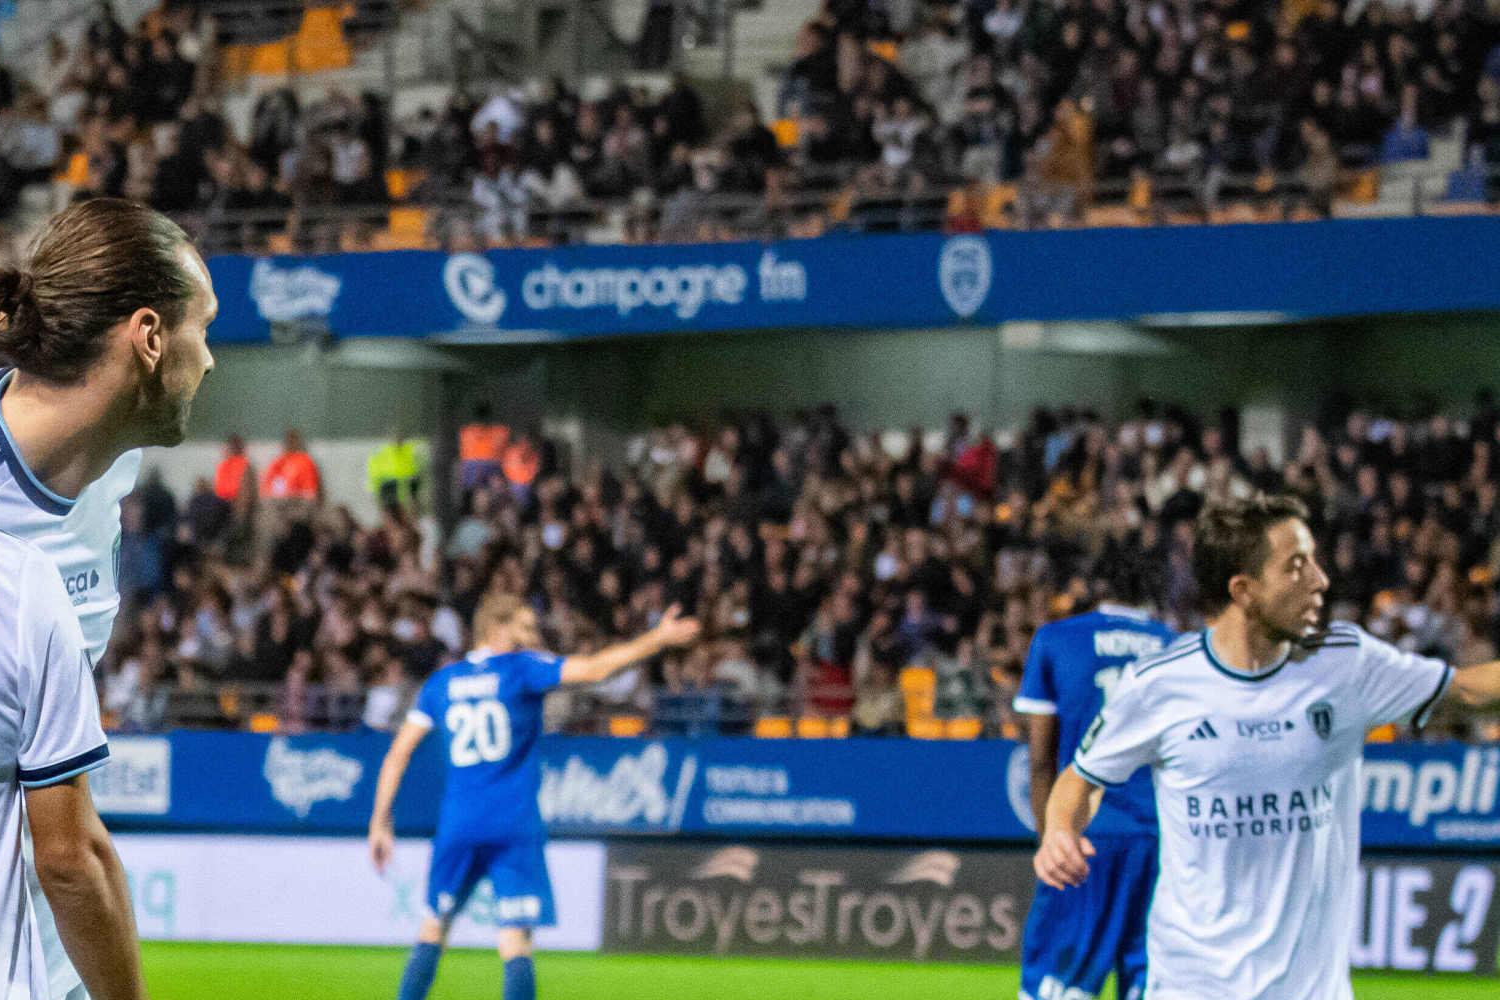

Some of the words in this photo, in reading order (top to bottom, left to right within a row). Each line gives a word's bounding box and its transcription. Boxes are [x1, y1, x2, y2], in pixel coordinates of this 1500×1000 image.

[522, 261, 747, 319] champagne
[759, 250, 807, 301] fm
[445, 699, 513, 768] 20
[1237, 719, 1282, 738] Lyca
[1186, 784, 1332, 819] BAHRAIN
[1188, 809, 1333, 839] VICTORIOUS
[1433, 863, 1495, 972] 2
